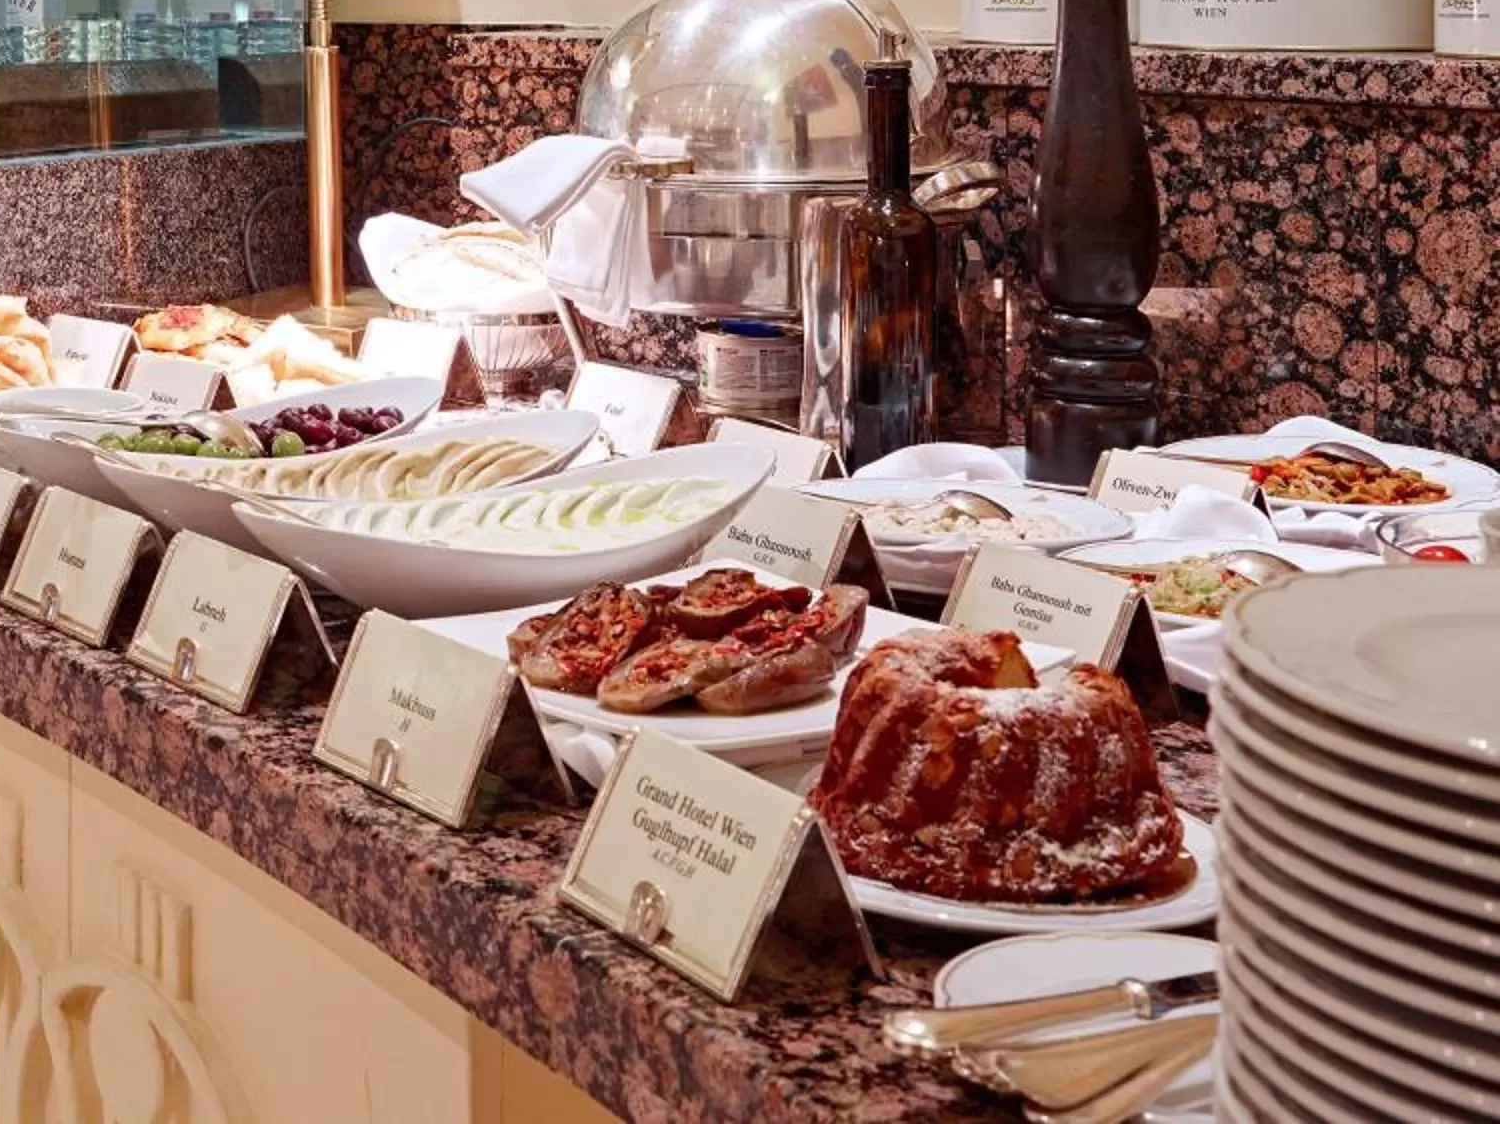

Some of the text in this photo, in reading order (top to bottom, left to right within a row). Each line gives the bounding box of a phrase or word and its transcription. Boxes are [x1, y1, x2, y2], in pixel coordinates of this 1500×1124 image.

[1193, 6, 1228, 18] WIEN
[1112, 477, 1179, 501] Oliven-Zwi
[727, 525, 753, 545] Baba
[192, 595, 227, 623] Labneh
[990, 575, 1015, 594] Baba
[1073, 603, 1093, 617] mit
[636, 774, 757, 852] Grand Hotel Wien
[631, 806, 738, 876] Guglhupf Halal
